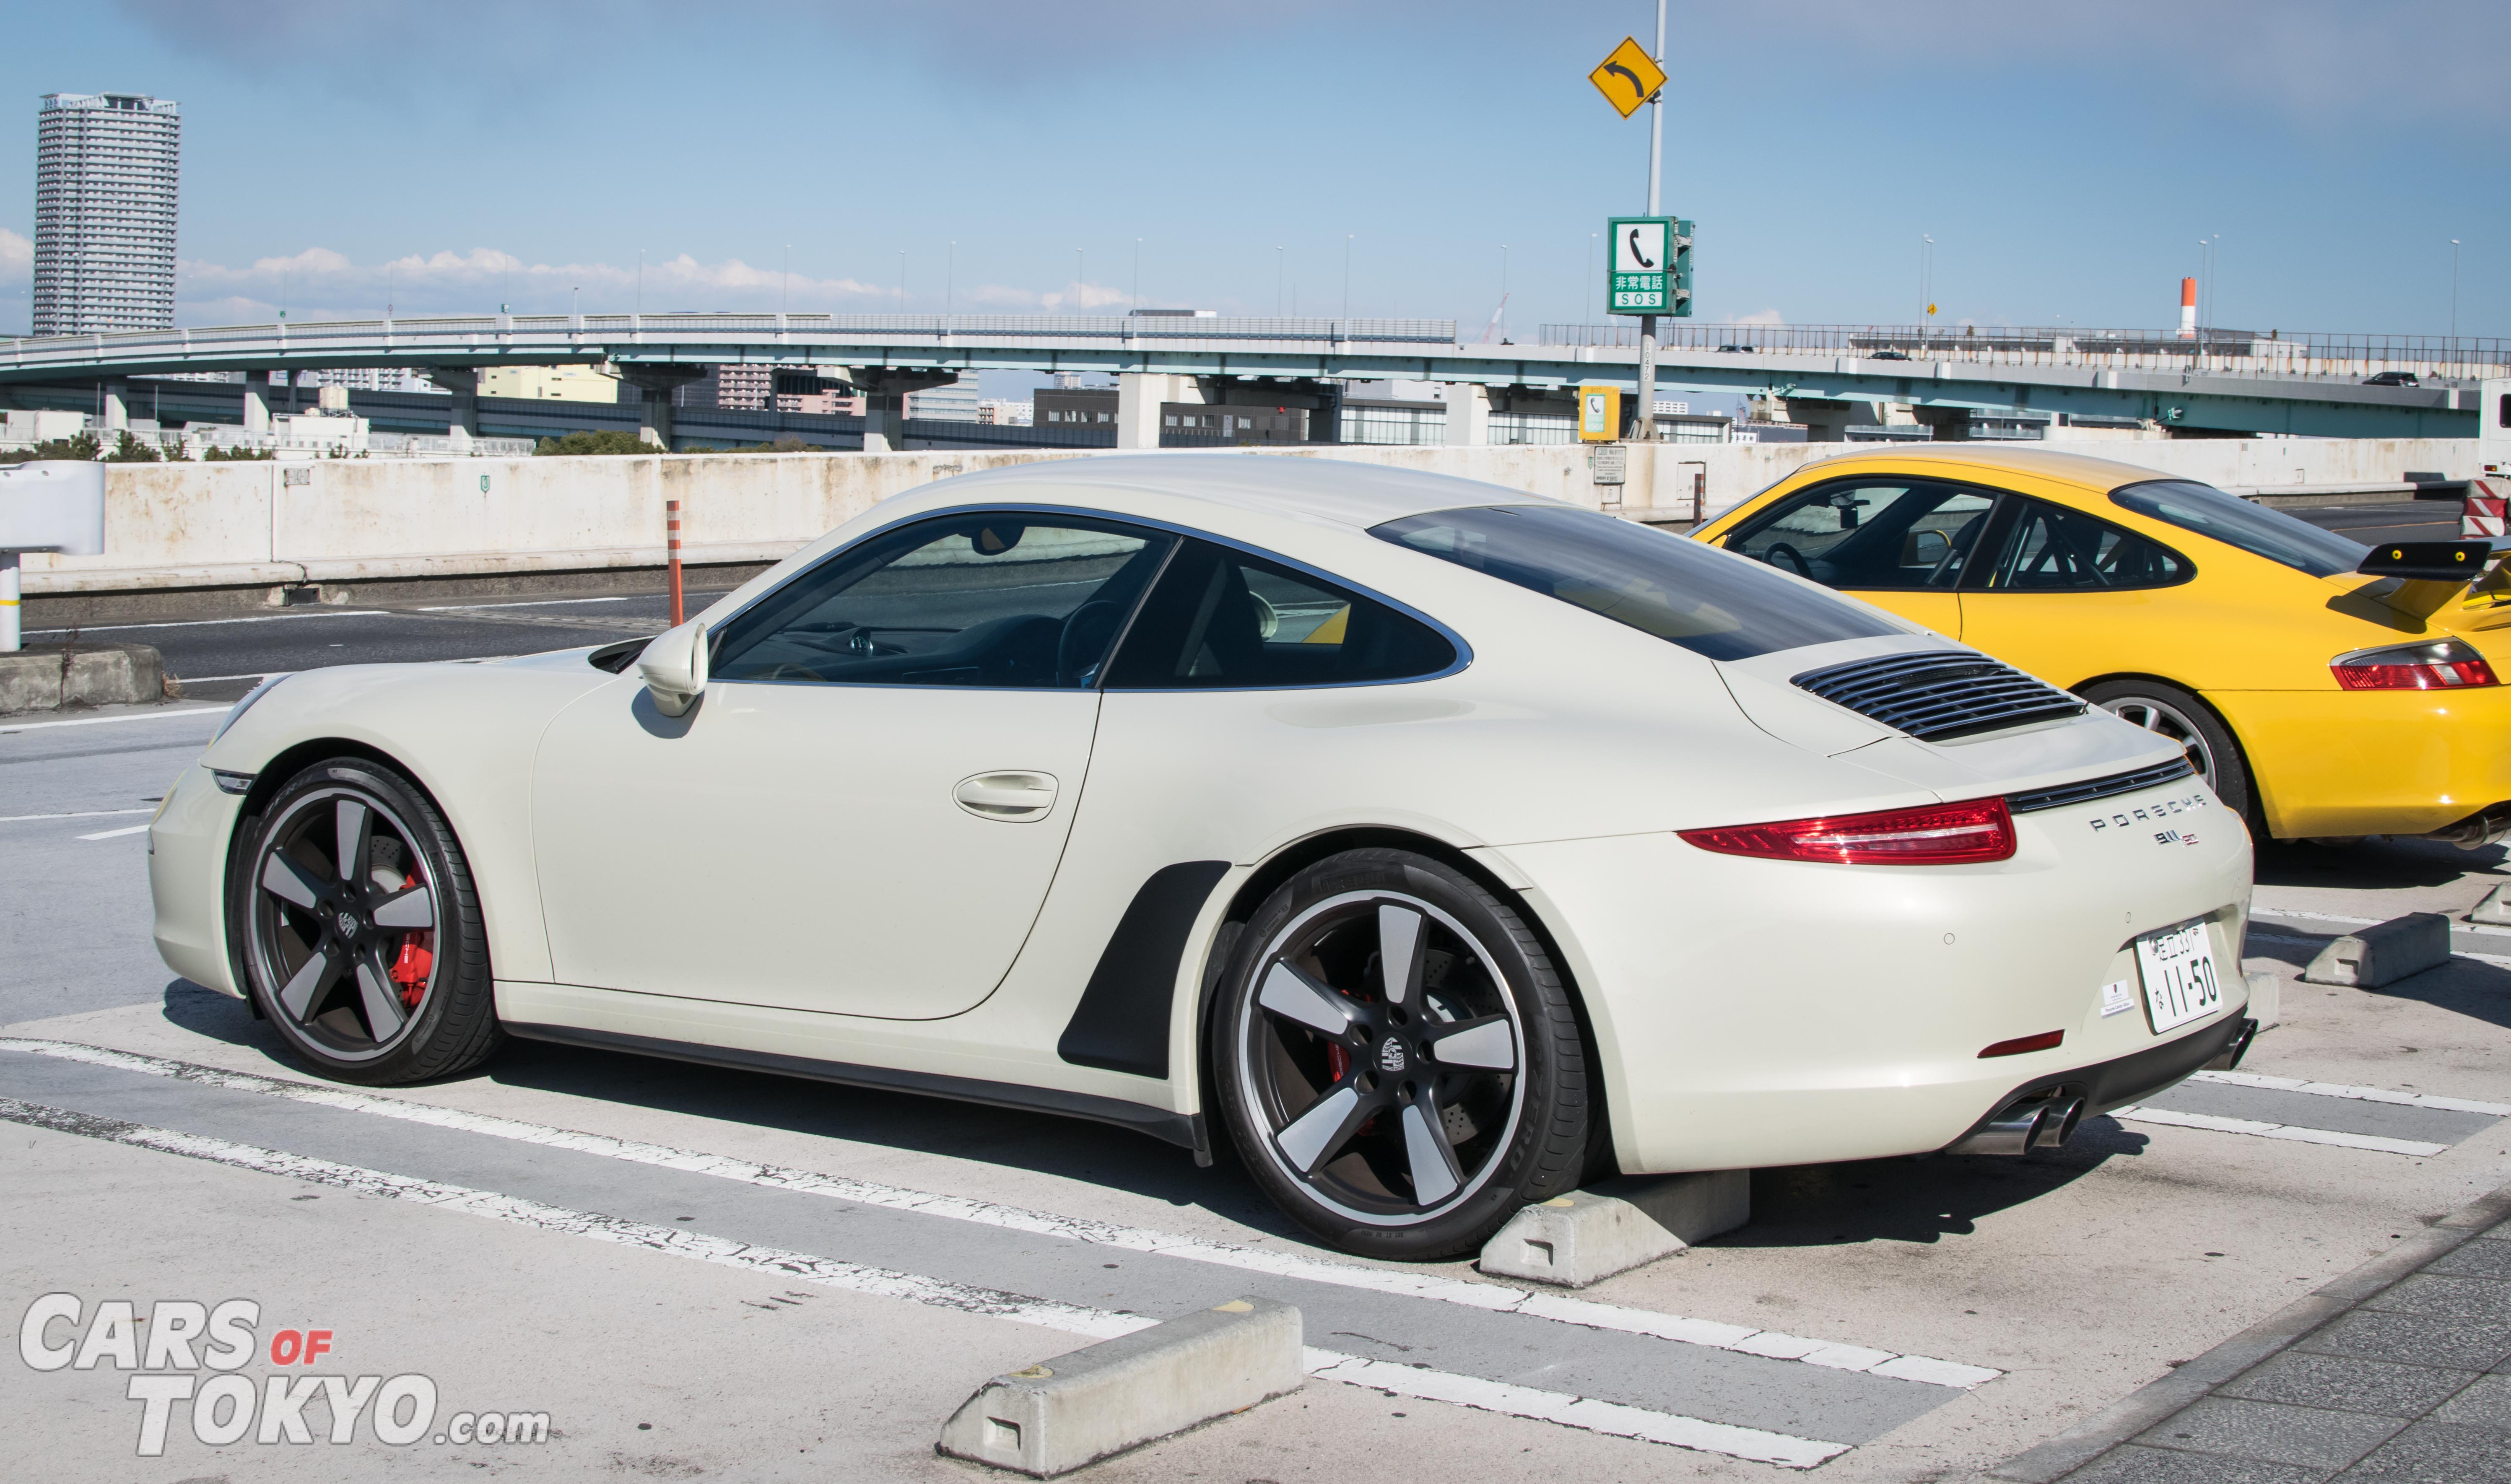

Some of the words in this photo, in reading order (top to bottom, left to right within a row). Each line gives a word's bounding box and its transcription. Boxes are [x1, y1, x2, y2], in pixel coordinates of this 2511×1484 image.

[1616, 275, 1663, 290] 非常電話
[2089, 794, 2207, 833] PORSCHE
[2153, 830, 2181, 846] 911
[2164, 956, 2217, 1017] 11-50
